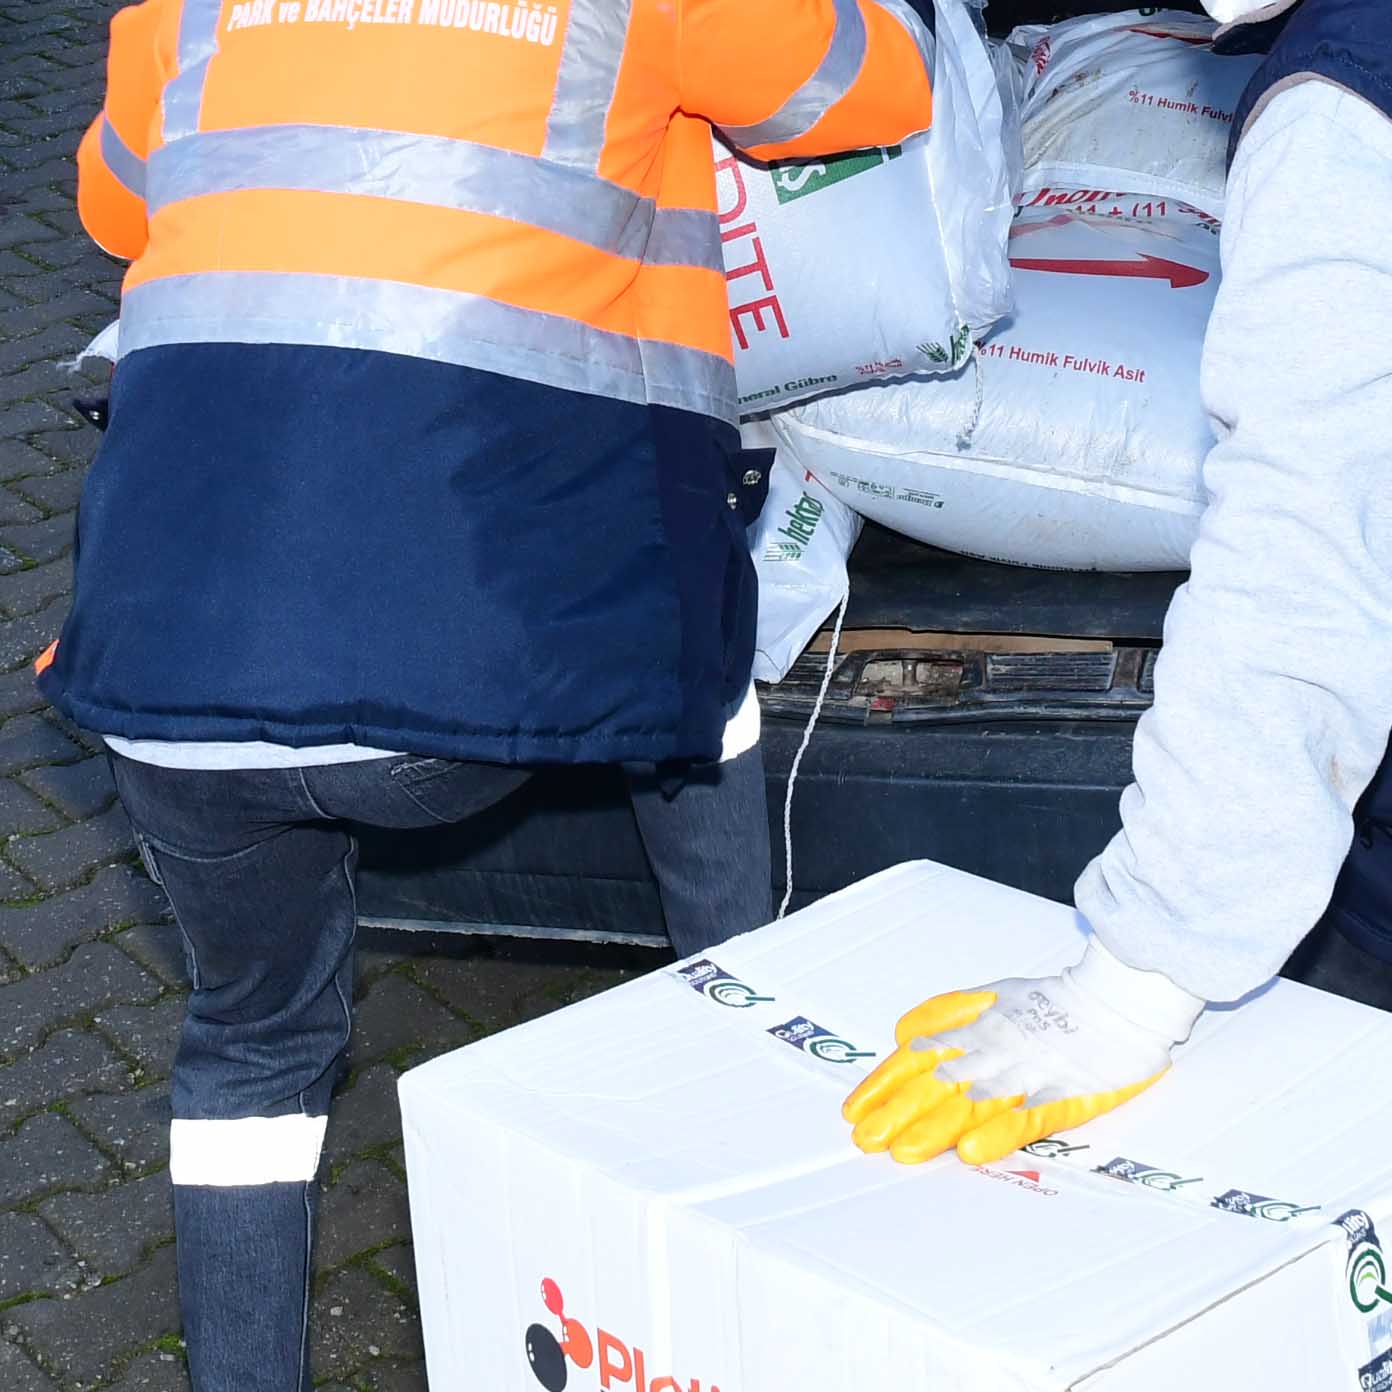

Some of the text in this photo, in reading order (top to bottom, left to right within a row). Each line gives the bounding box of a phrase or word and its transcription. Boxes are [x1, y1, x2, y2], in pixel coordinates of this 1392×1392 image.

[279, 2, 300, 22] ve
[1128, 90, 1154, 105] %11
[1157, 97, 1198, 114] Humik
[1009, 345, 1059, 367] Humik
[1063, 355, 1111, 376] Fulvik
[1113, 364, 1147, 384] Asit
